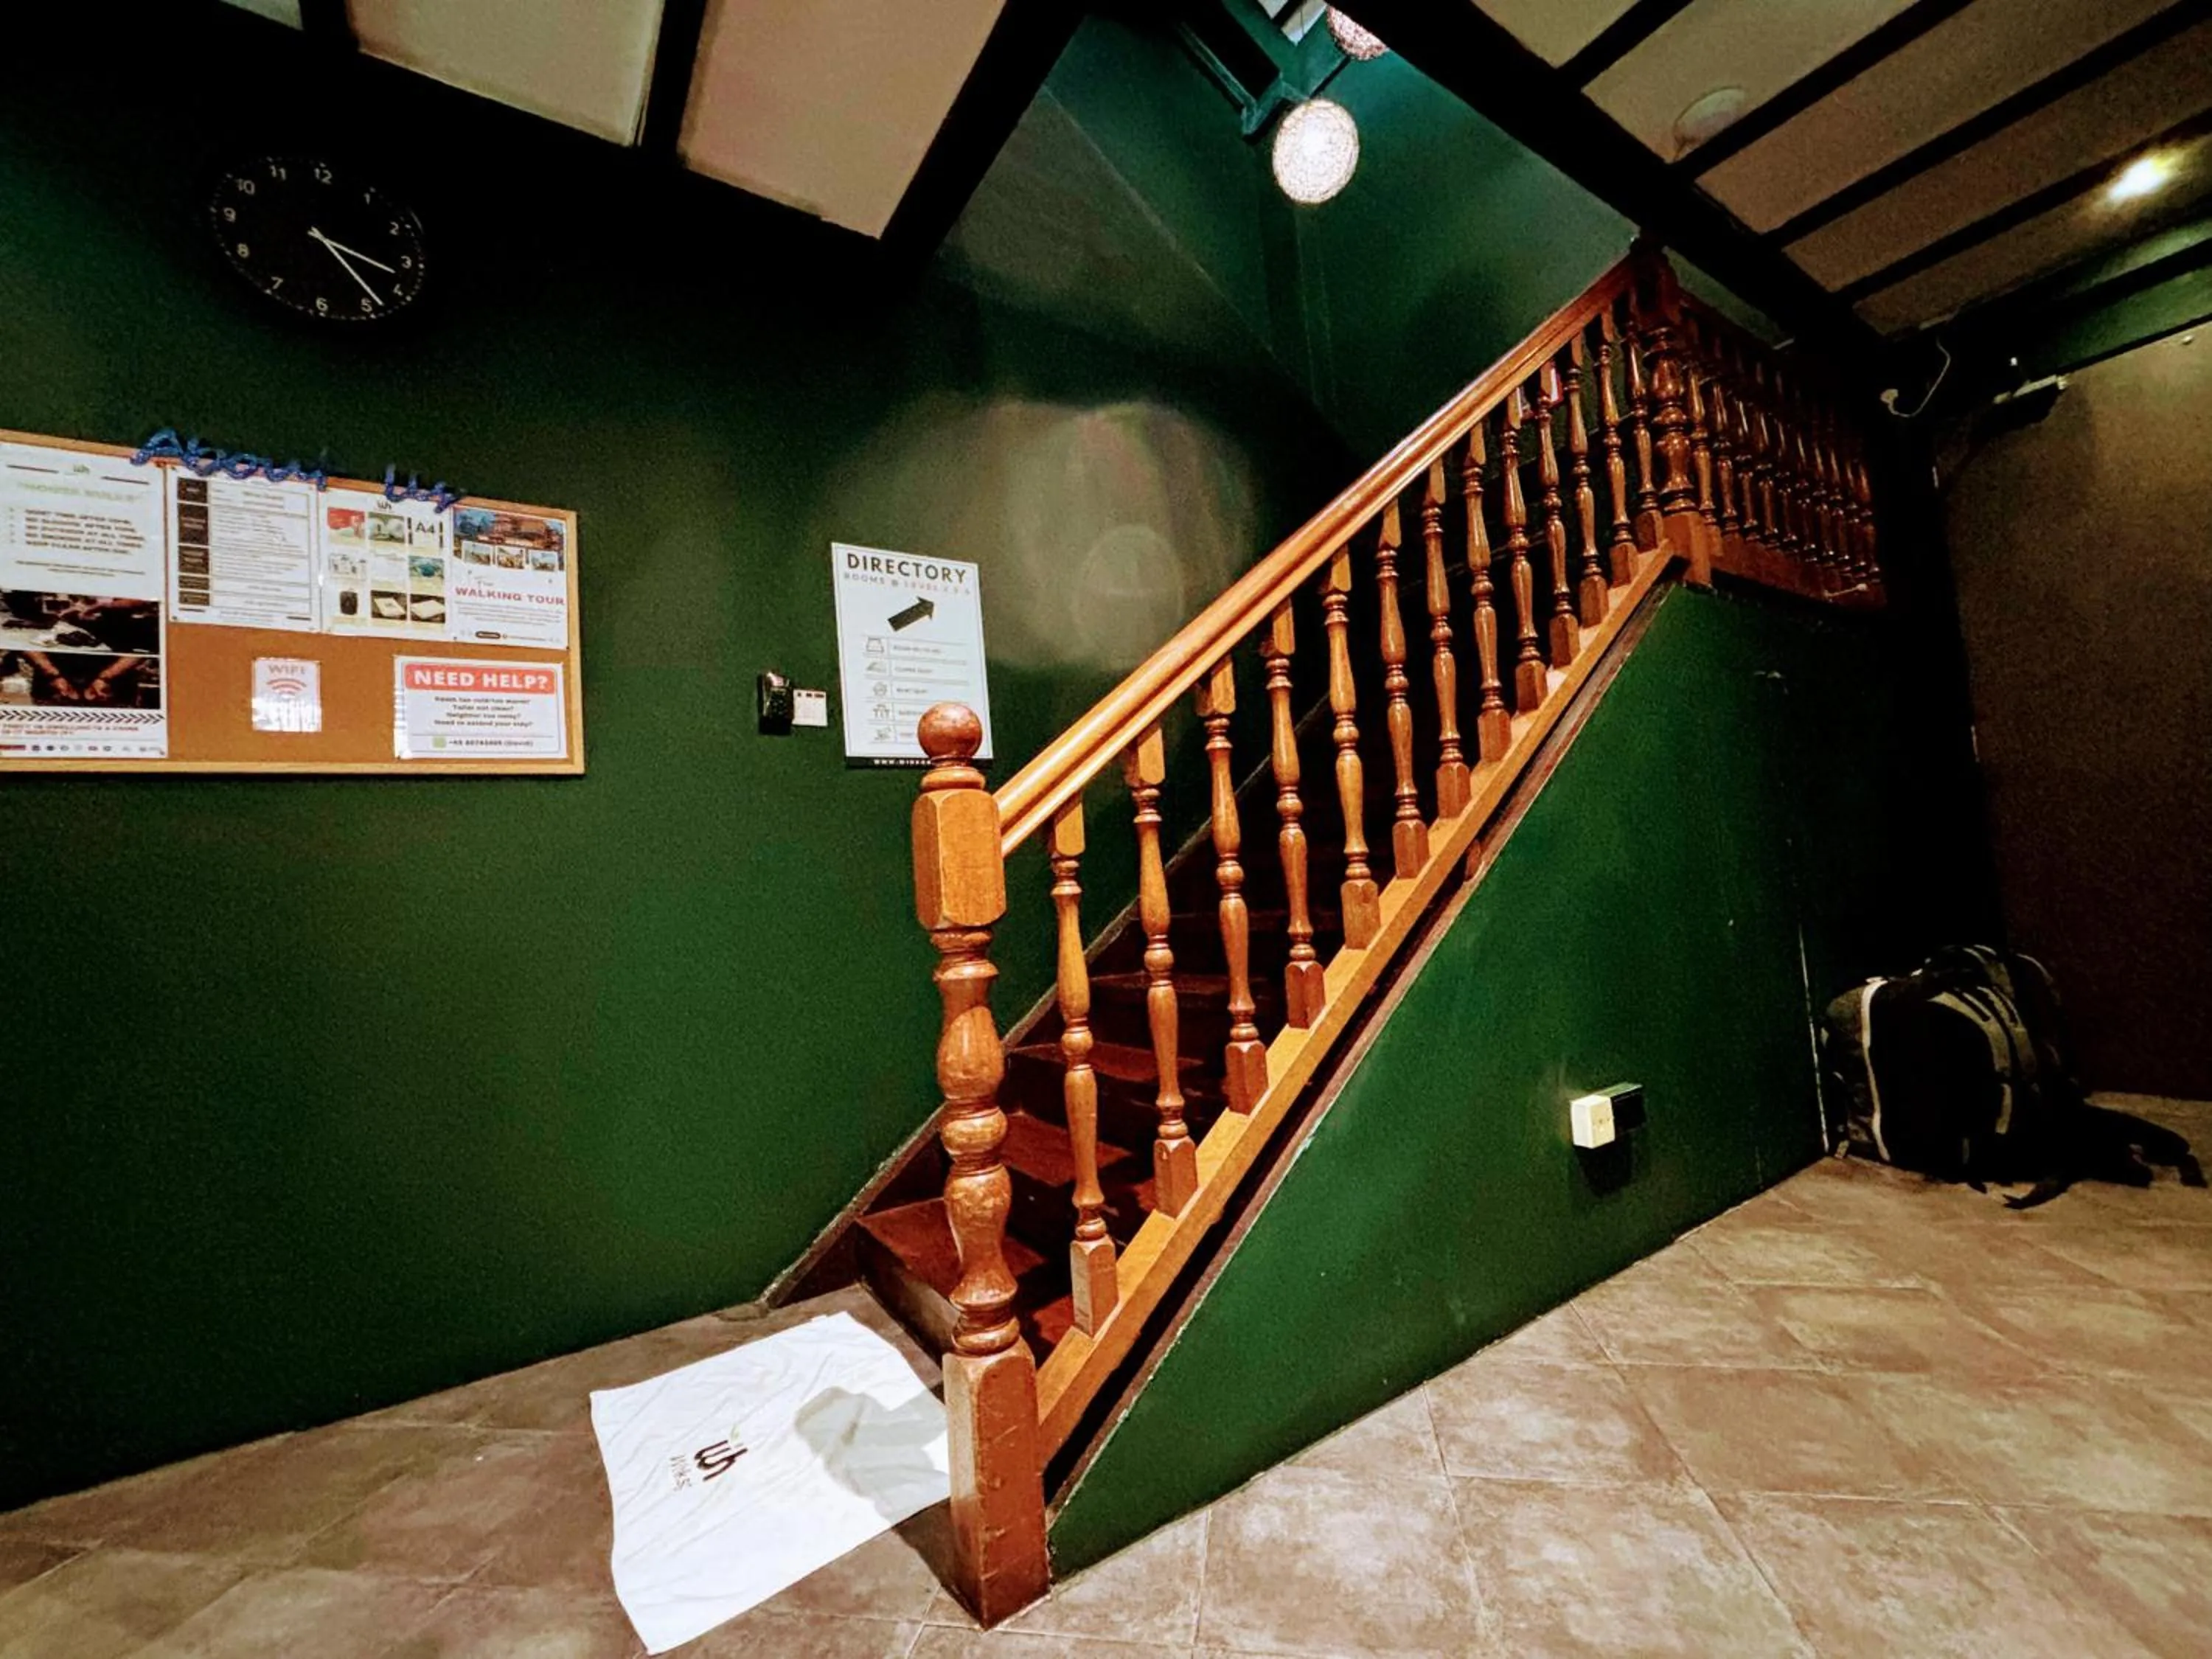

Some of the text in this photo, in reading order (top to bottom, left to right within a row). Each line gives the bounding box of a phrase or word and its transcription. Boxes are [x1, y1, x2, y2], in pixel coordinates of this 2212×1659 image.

[270, 164, 286, 181] 11
[314, 167, 332, 184] 12
[237, 178, 255, 195] 10
[364, 192, 371, 205] 1
[223, 207, 237, 223] 9
[389, 221, 399, 236] 2
[237, 243, 249, 258] 8
[400, 255, 412, 269] 3
[271, 276, 284, 290] 7
[392, 284, 403, 296] 4
[316, 297, 328, 312] 6
[361, 297, 372, 313] 5
[847, 553, 968, 585] DIRECTORY
[455, 585, 566, 606] WALKING TOUR
[268, 664, 305, 675] WIFI
[413, 669, 550, 690] NEED HELP?
